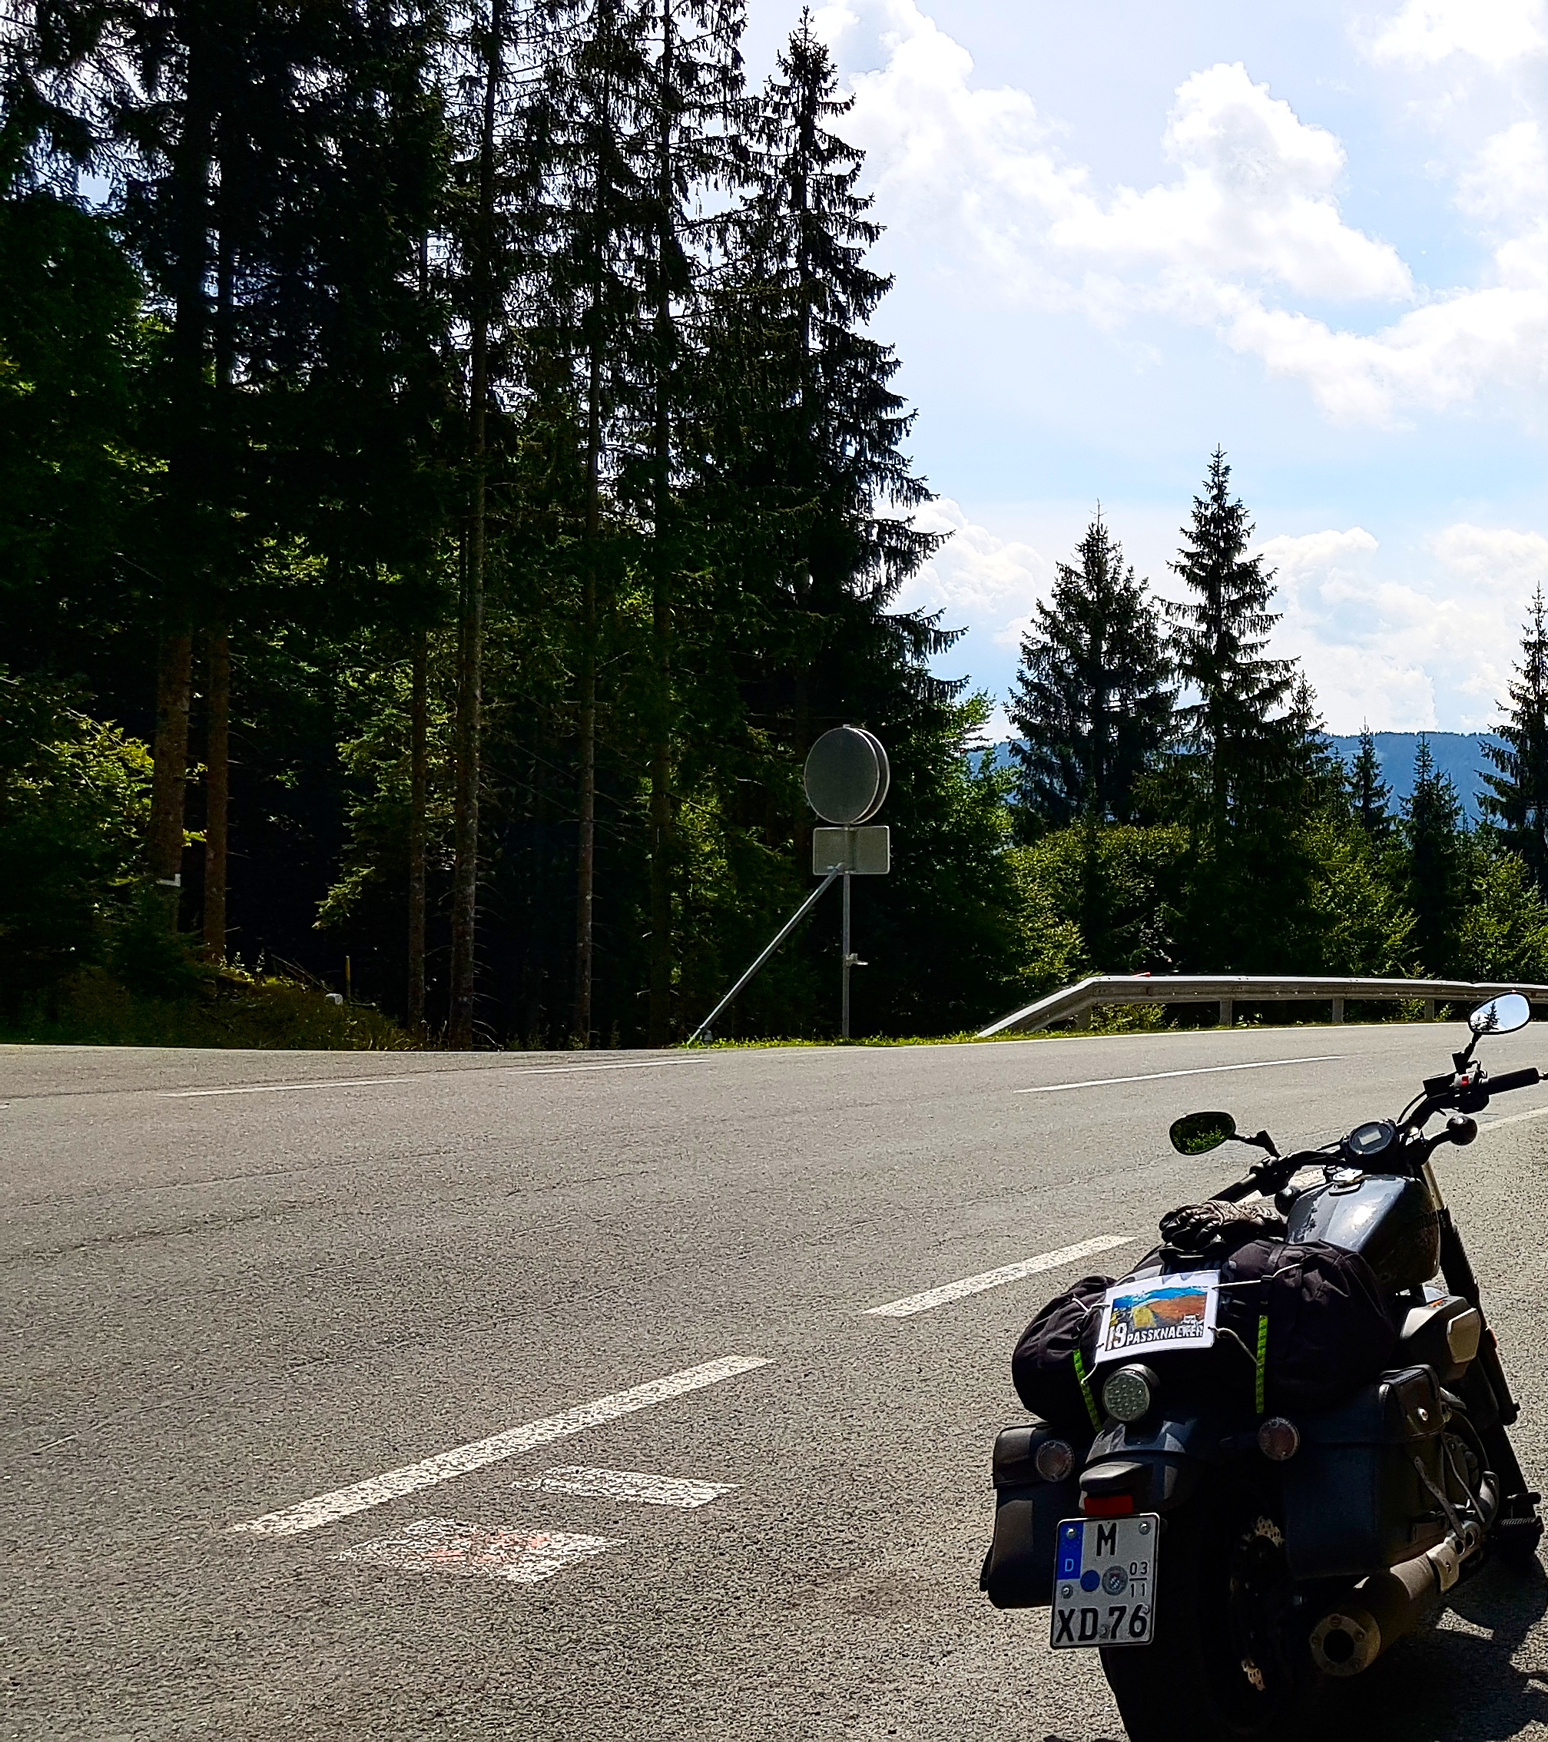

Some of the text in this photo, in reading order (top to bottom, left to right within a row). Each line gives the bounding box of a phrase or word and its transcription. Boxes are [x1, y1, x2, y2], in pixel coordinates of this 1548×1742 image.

[1107, 1322, 1128, 1350] 19
[1096, 1522, 1117, 1556] M
[1064, 1558, 1074, 1572] D
[1129, 1561, 1149, 1575] 03
[1130, 1583, 1146, 1597] 11
